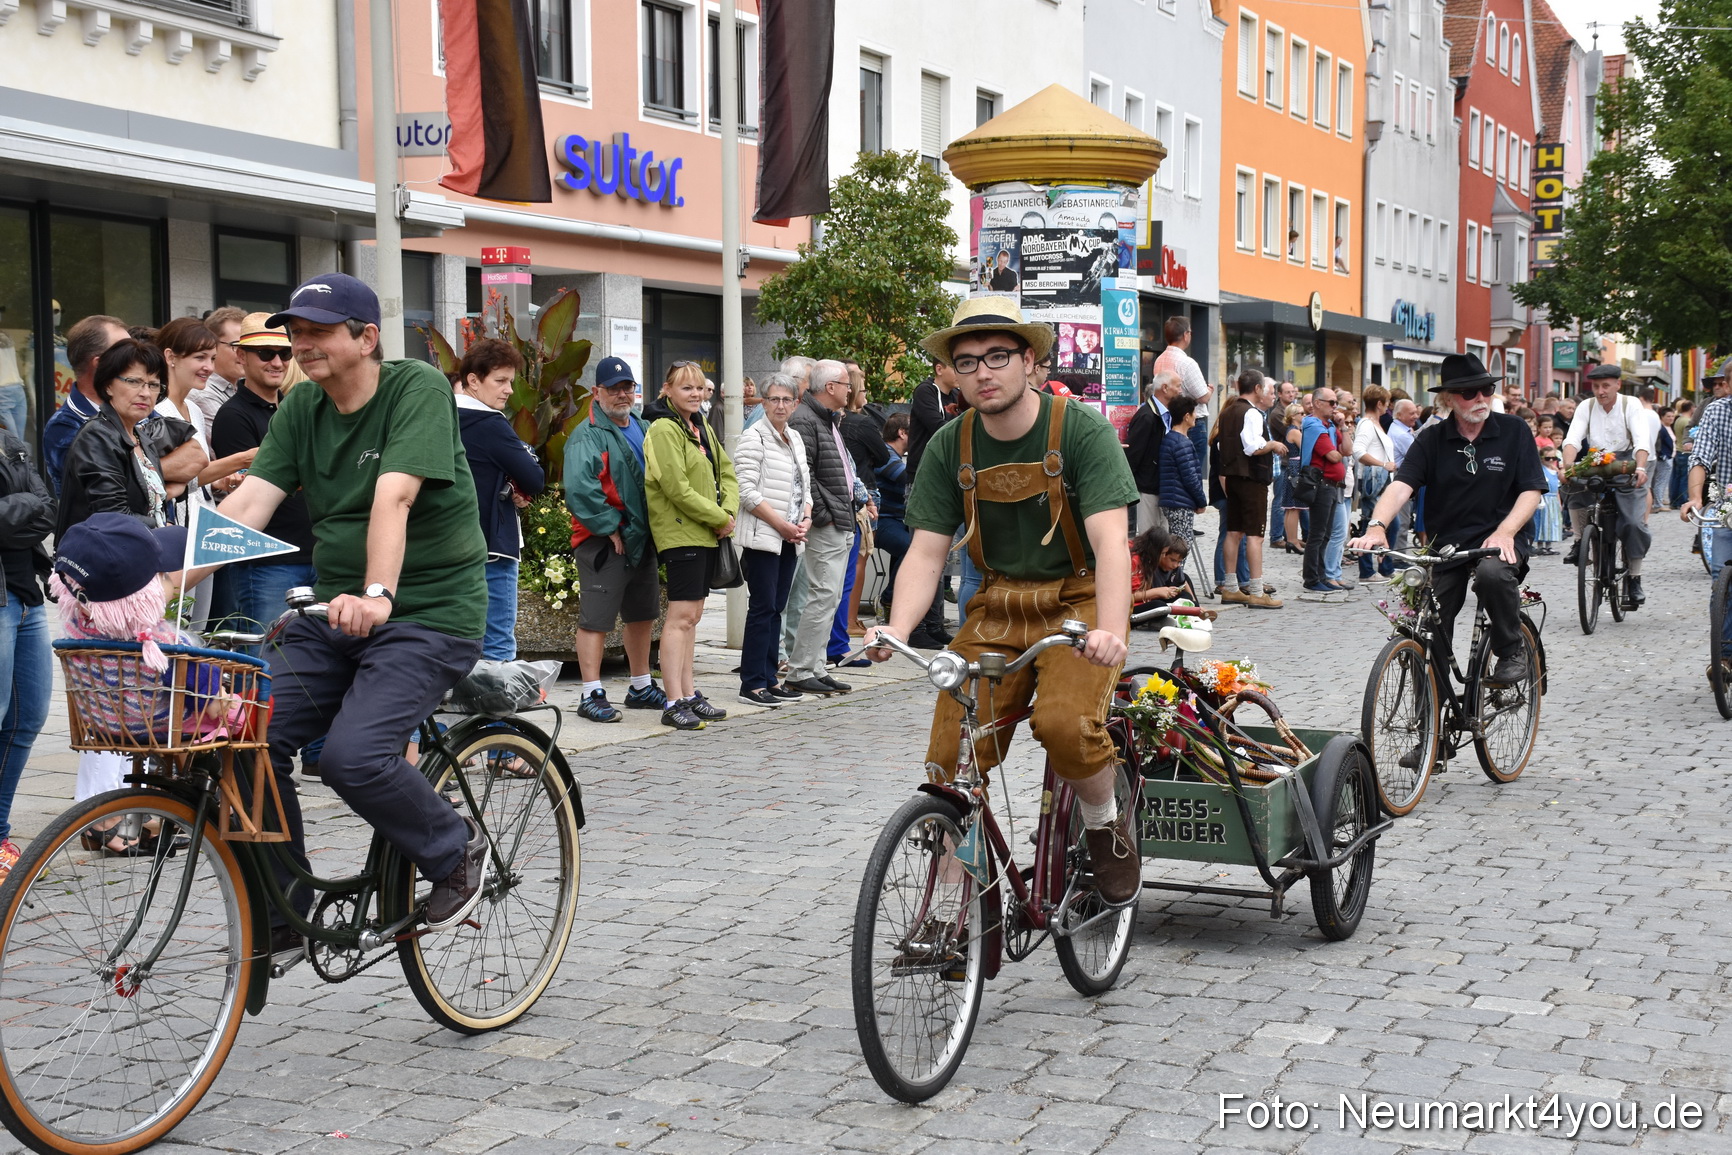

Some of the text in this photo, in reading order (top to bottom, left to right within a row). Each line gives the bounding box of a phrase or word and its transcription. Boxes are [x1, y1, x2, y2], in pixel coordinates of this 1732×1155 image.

[556, 132, 685, 208] sutor.
[1057, 213, 1091, 223] Amanda
[1535, 147, 1563, 278] HOTE
[1000, 242, 1016, 250] LIVE
[1022, 234, 1045, 245] ADAC
[1022, 240, 1068, 254] NORDBAYERN
[1088, 238, 1101, 248] CUP
[495, 248, 507, 263] T
[1029, 252, 1064, 262] MOTOCROSS
[201, 540, 246, 555] EXPRESS
